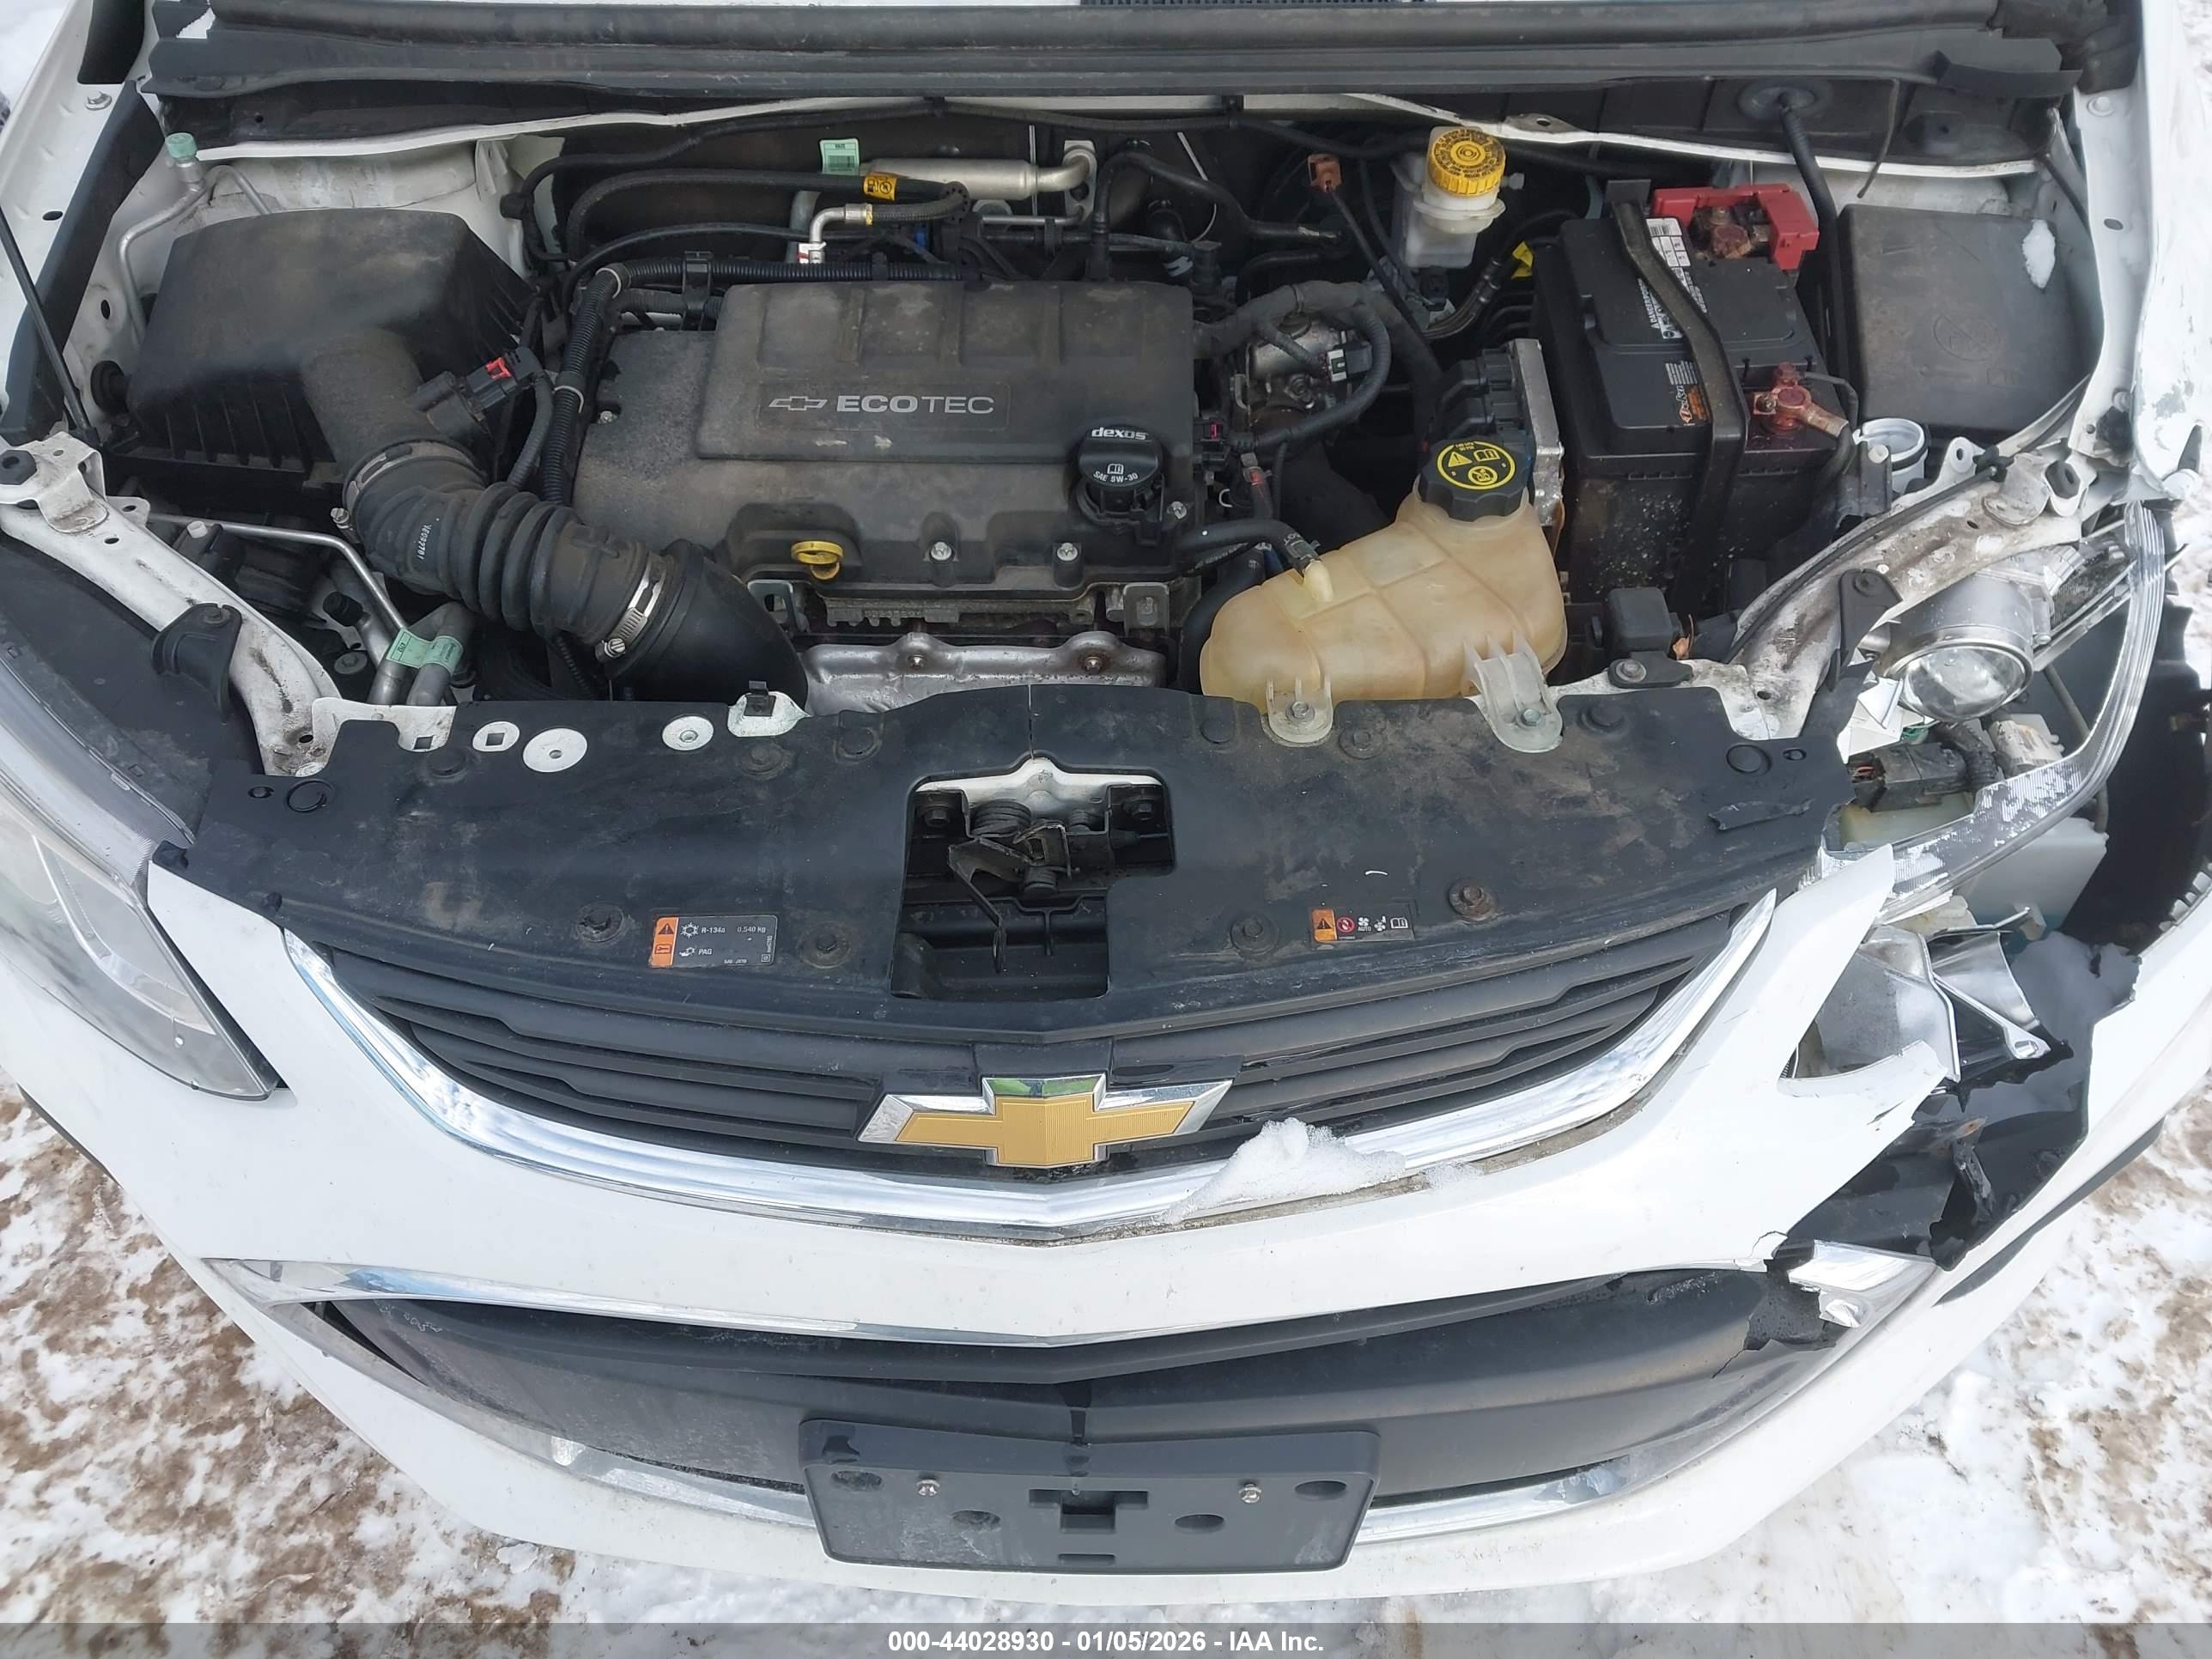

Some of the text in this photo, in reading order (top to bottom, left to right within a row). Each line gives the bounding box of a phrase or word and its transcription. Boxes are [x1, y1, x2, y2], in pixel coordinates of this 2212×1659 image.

[836, 395, 994, 414] ECOTEC
[1091, 427, 1147, 441] dexos
[1093, 471, 1139, 483] SAE 5W-30
